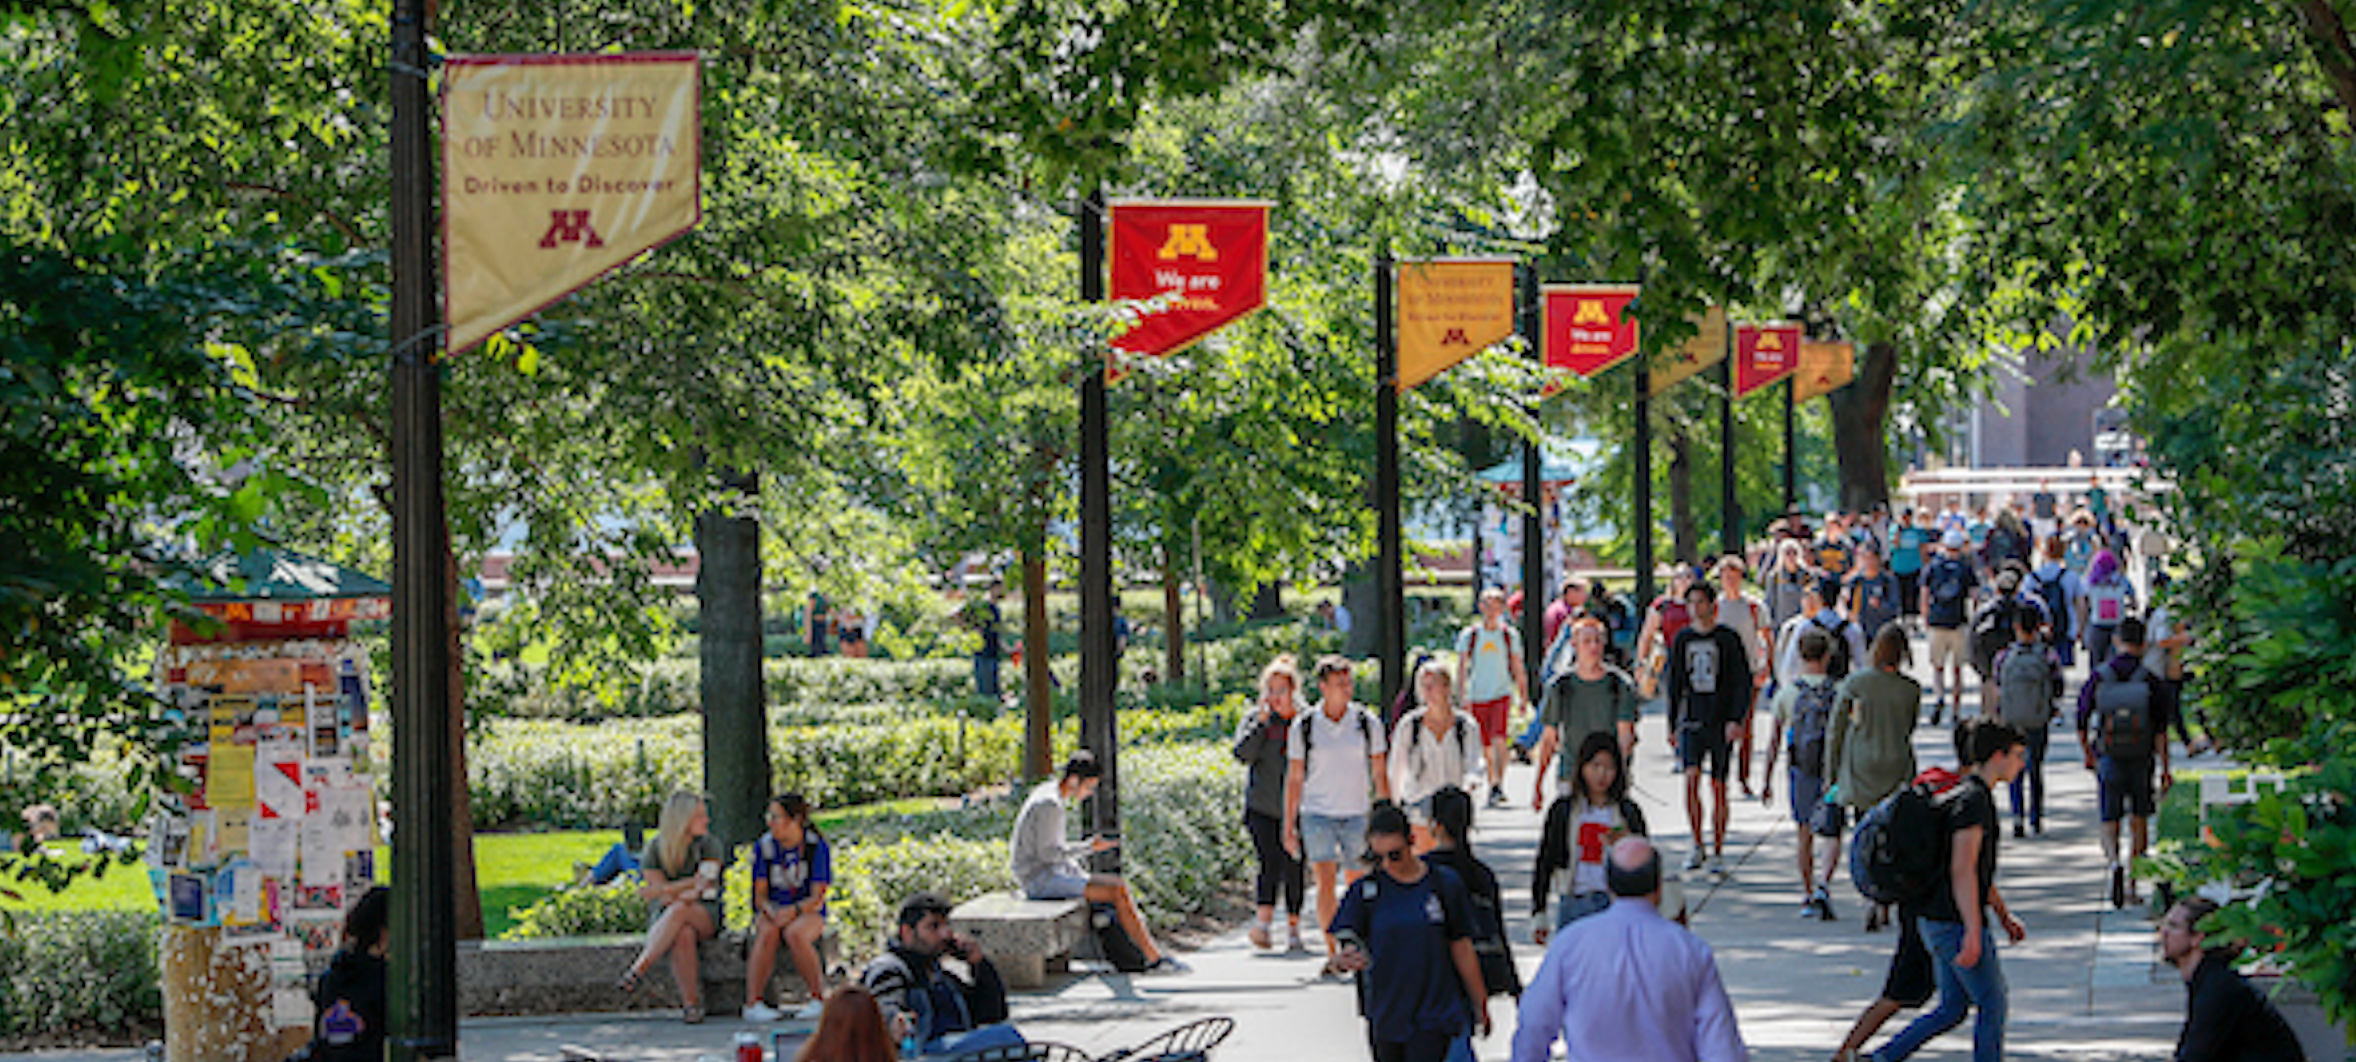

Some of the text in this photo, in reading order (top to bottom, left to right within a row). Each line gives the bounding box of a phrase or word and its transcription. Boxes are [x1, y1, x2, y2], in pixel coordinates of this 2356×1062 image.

[484, 91, 657, 120] UNIVERSITY
[510, 130, 675, 159] MINNESOTA
[463, 173, 675, 194] Driven to Discover
[1155, 269, 1221, 290] We are
